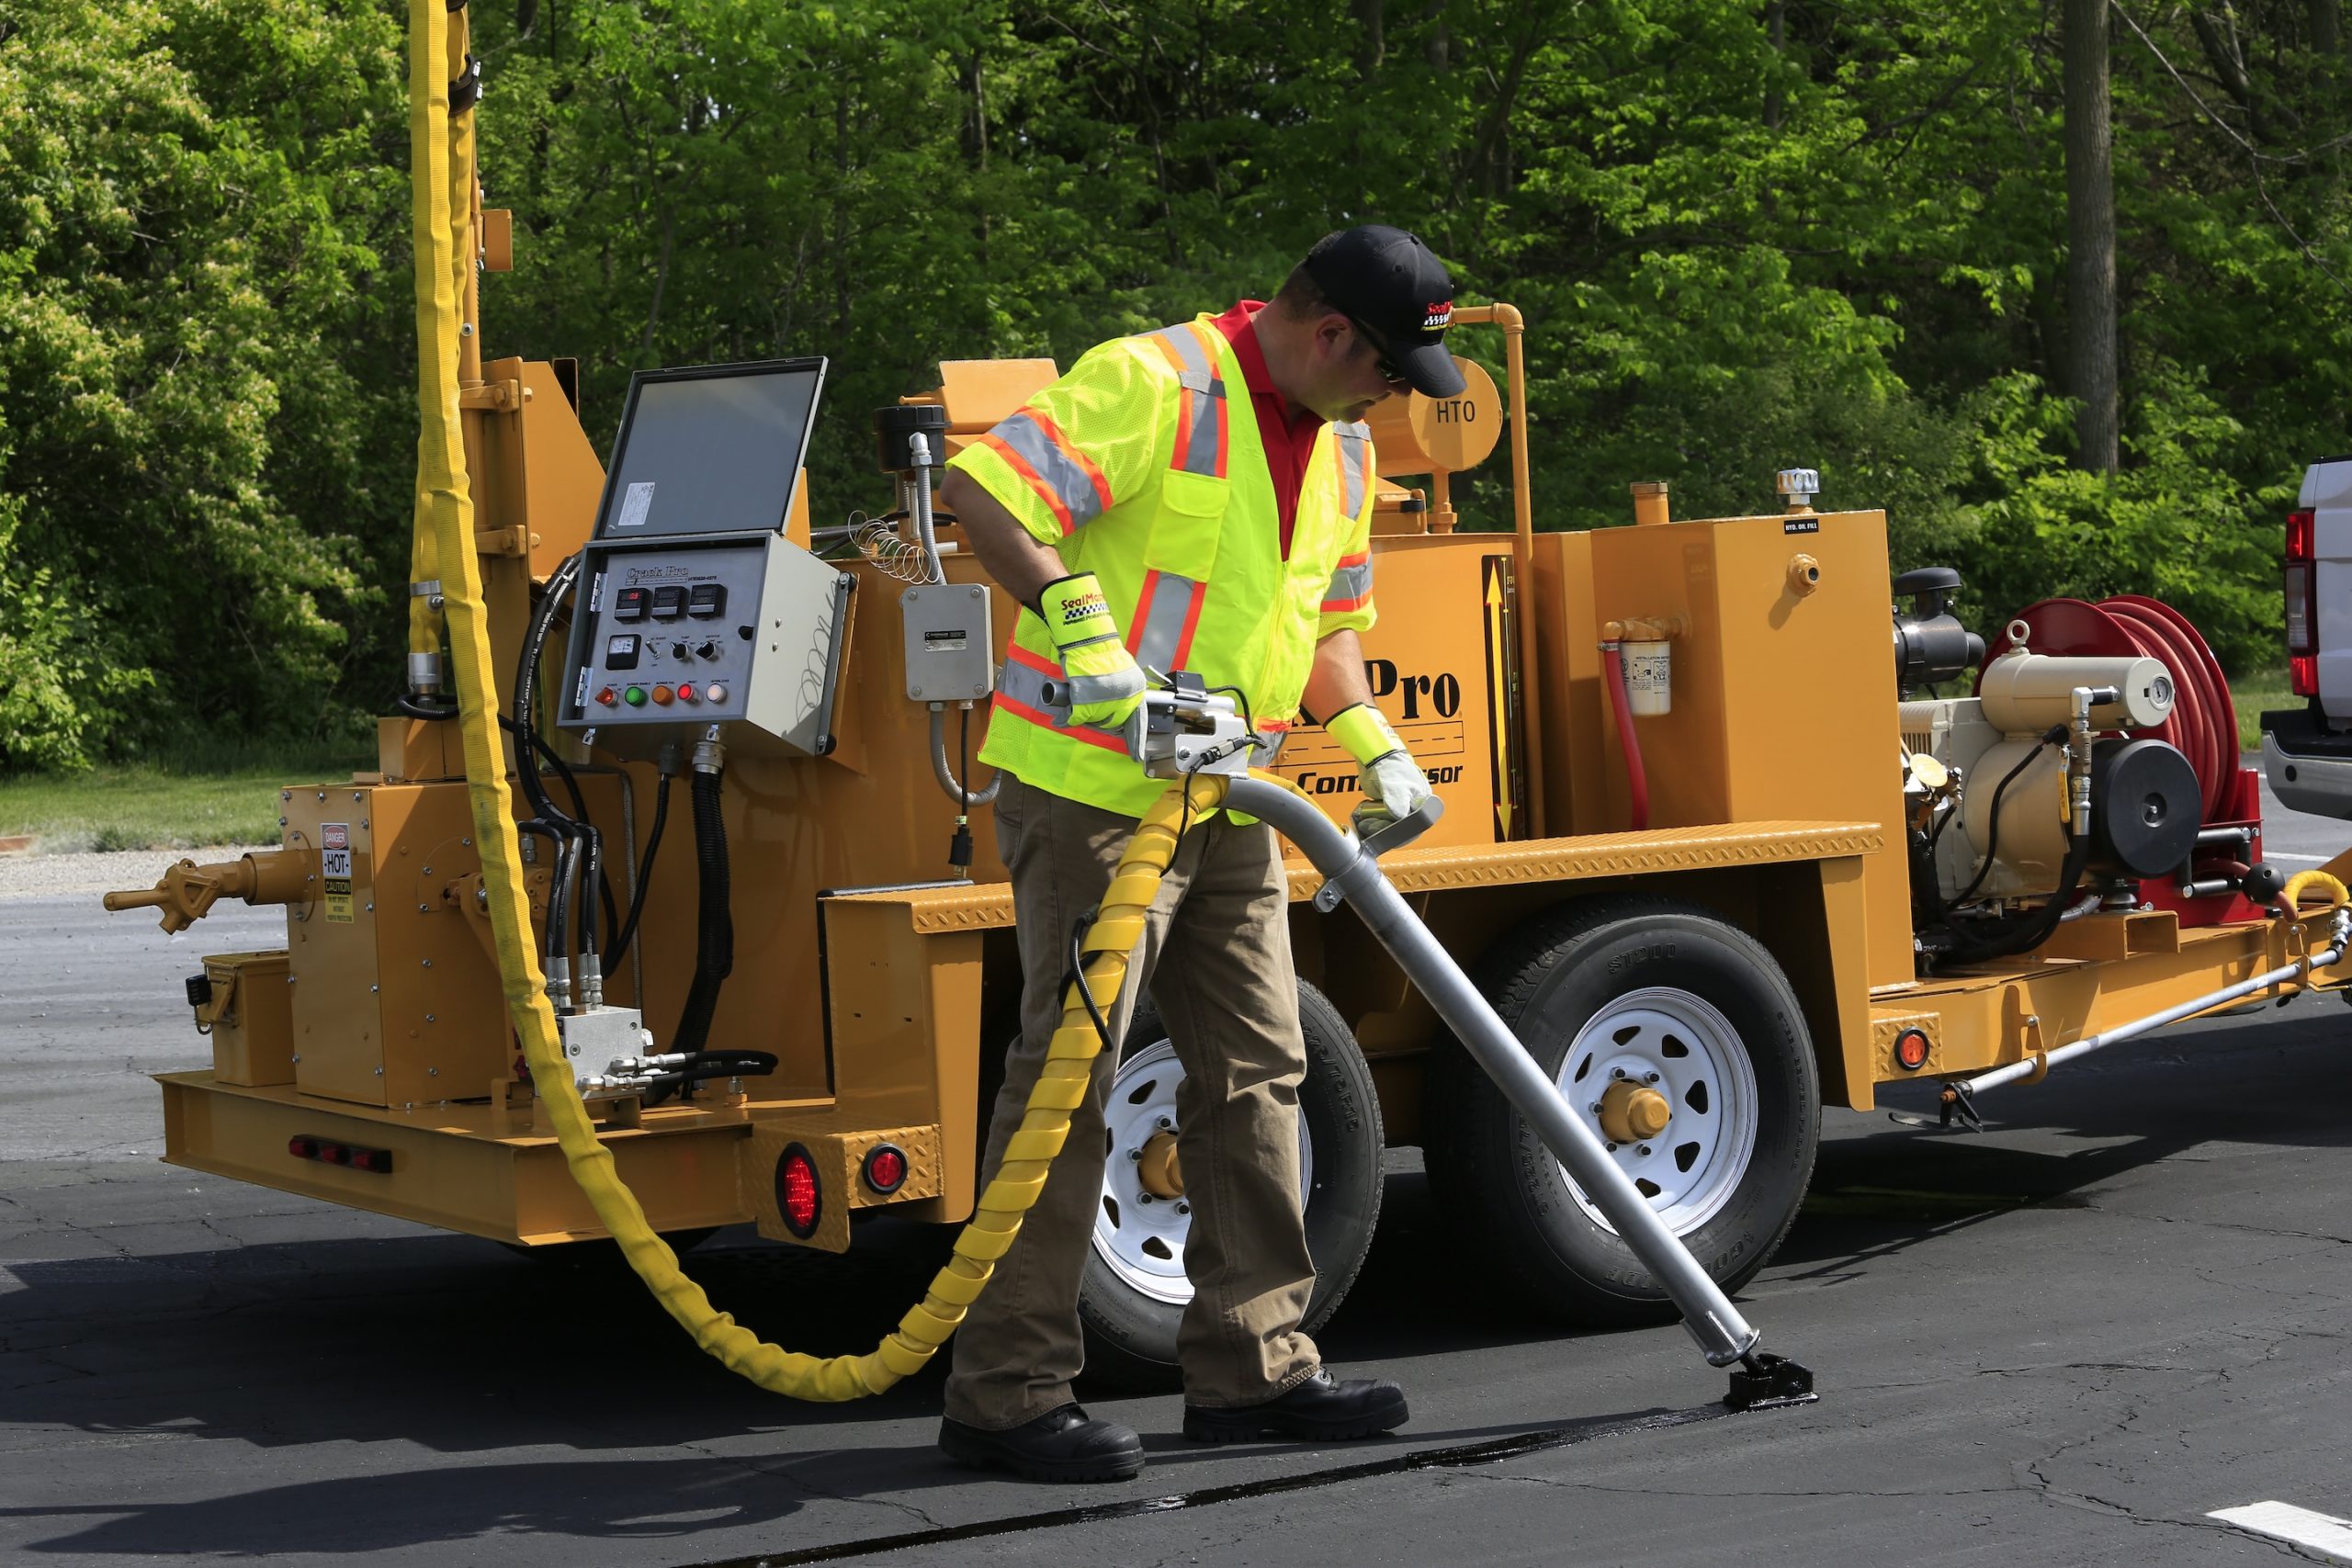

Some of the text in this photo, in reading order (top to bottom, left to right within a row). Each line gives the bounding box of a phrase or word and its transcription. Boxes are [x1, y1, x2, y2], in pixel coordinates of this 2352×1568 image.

[1436, 400, 1476, 423] HTO
[627, 565, 688, 578] Crack Pro
[1363, 660, 1460, 720] Pro
[1297, 765, 1463, 795] Comsor
[325, 832, 345, 843] DANGER
[326, 853, 345, 874] HOT
[325, 881, 351, 893] CAUTION
